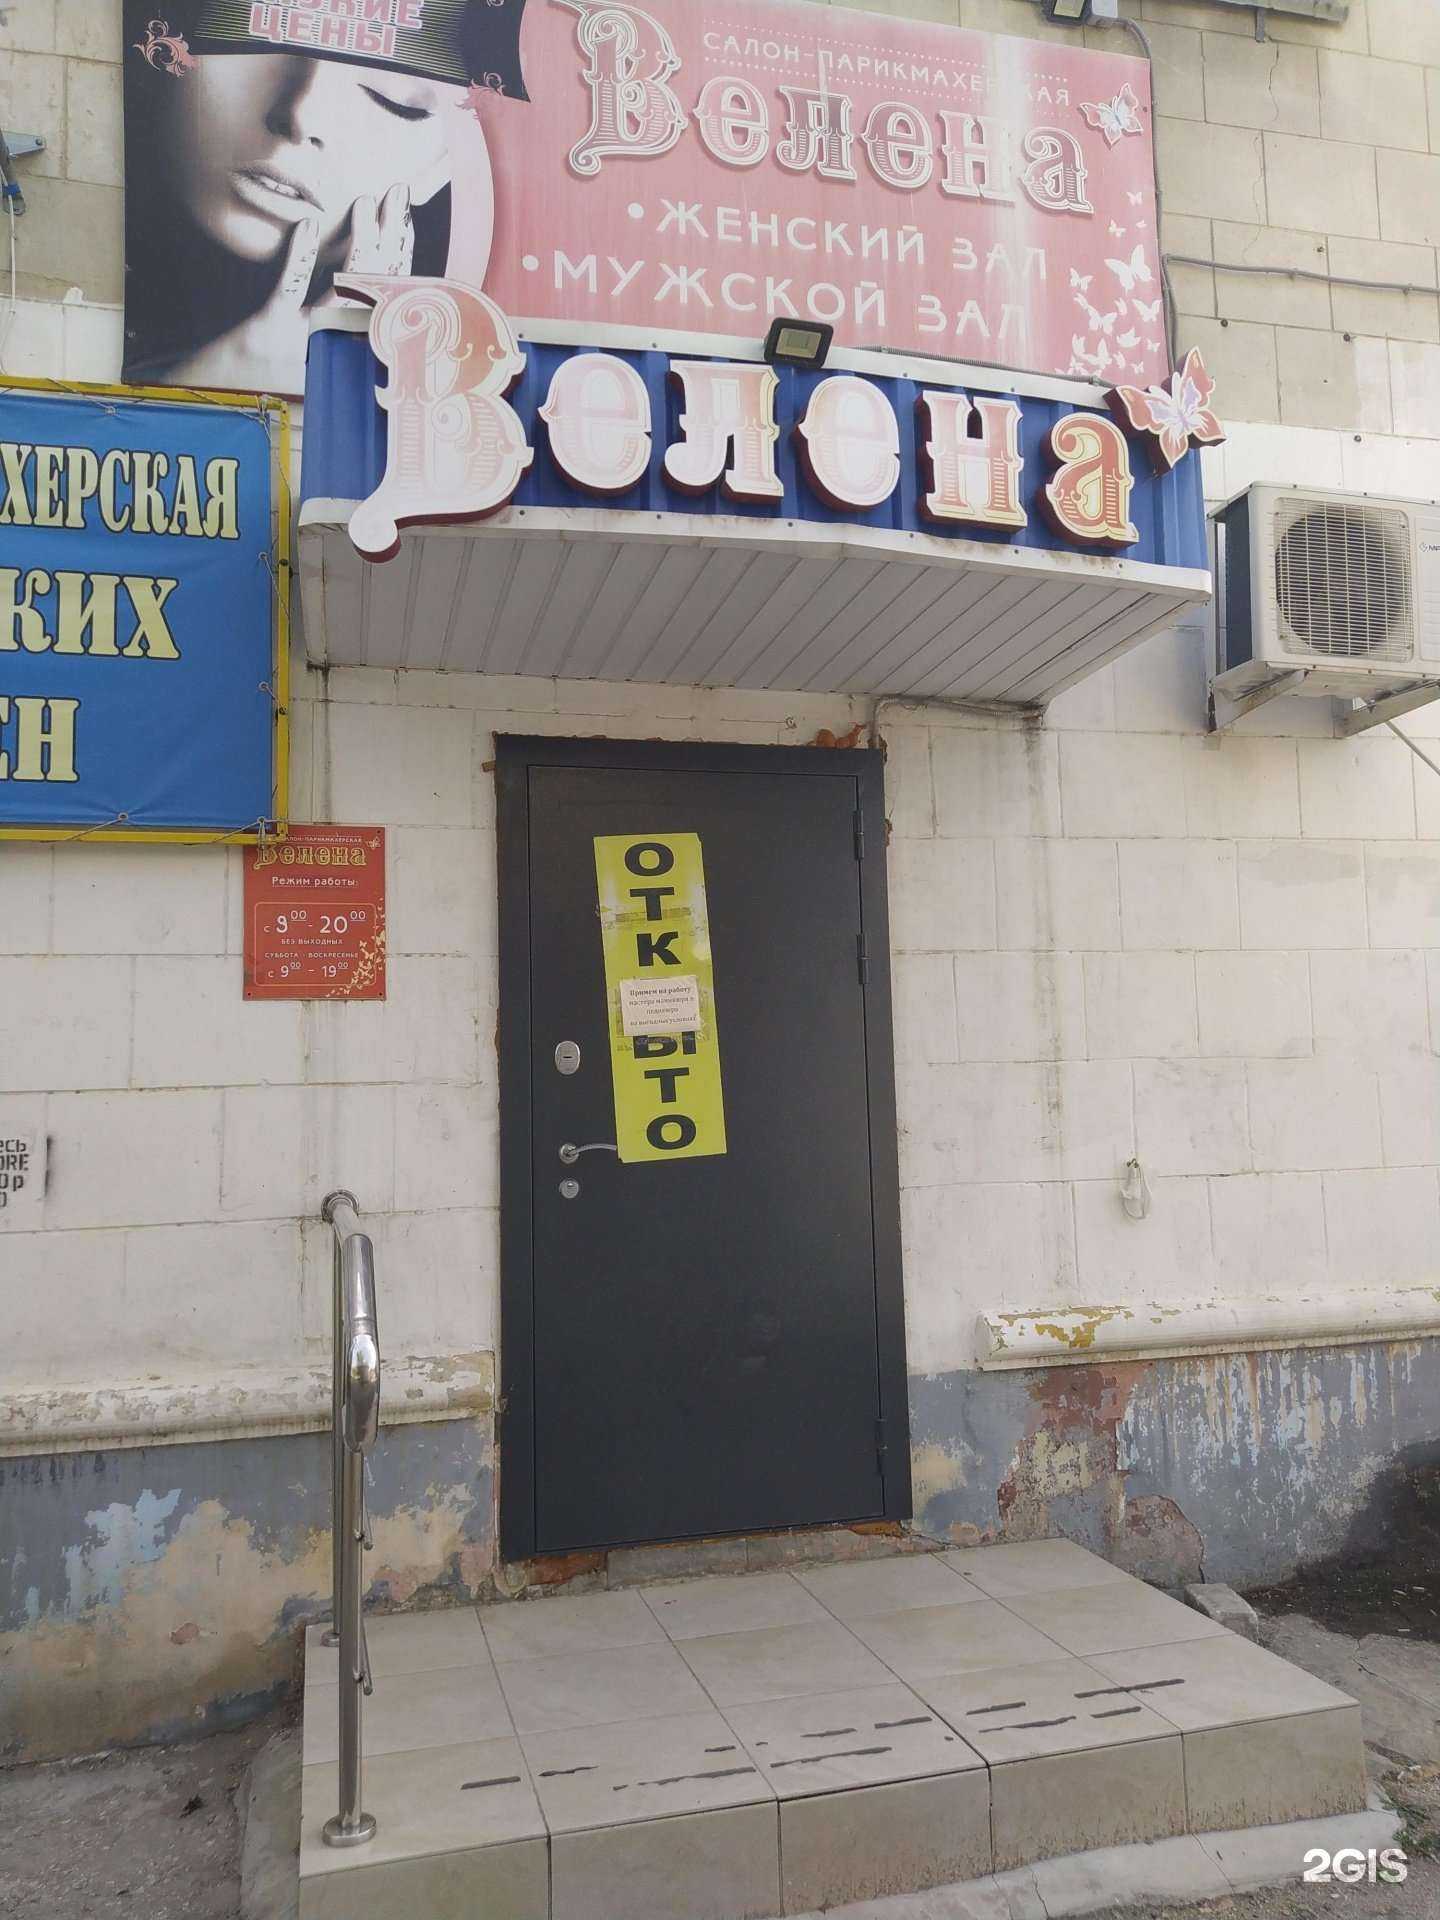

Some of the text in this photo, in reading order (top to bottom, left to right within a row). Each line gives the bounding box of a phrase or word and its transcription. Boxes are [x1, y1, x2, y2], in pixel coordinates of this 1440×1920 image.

[249, 3, 396, 57] ЦЕНЫ
[548, 0, 1094, 214] Велена
[656, 200, 1048, 281] ЖЕНСКИЙ ЗАЛ
[553, 249, 1027, 340] МУЖСКОЙ ЗАЛ
[333, 271, 1140, 560] Велена
[0, 442, 241, 540] ХЕРСКАЯ
[0, 696, 80, 783] Н
[254, 845, 366, 869] Велена
[272, 877, 310, 886] Режим
[624, 842, 697, 1150] ОТКЫТО
